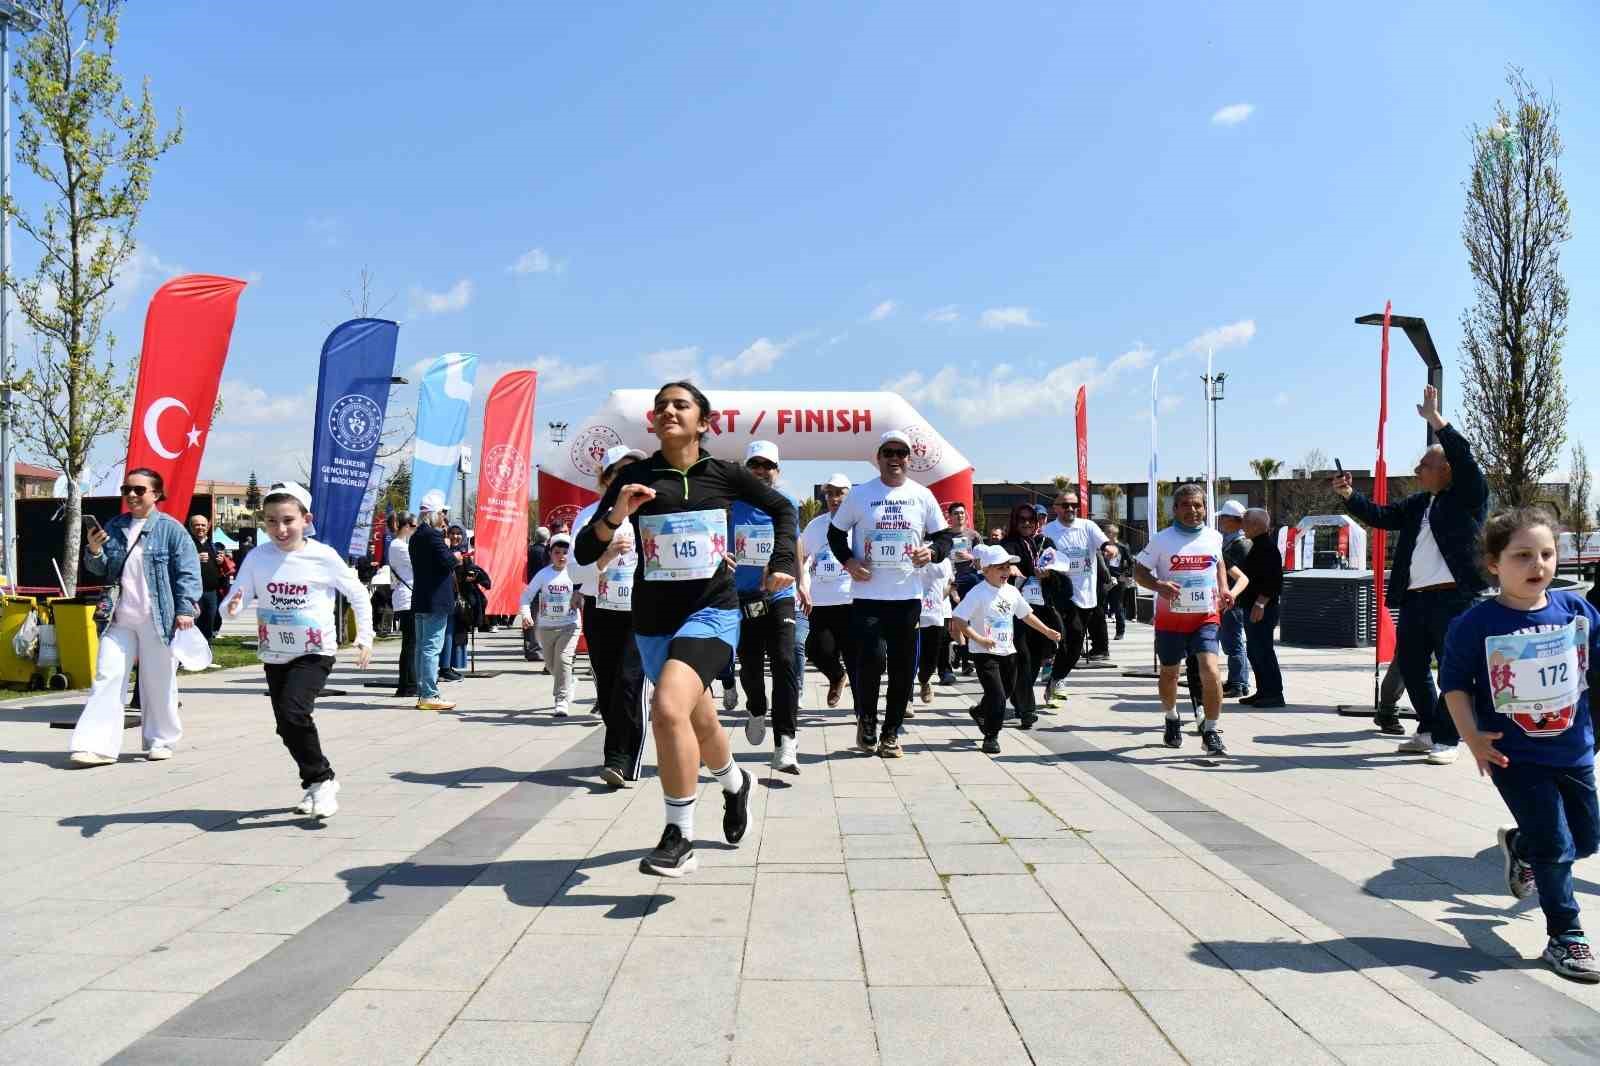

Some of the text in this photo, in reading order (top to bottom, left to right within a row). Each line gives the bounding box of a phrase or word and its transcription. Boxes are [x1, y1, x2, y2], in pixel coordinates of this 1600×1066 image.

[646, 409, 741, 435] SRT
[777, 409, 872, 434] FINISH
[672, 540, 697, 559] 145
[756, 542, 771, 553] 162
[880, 546, 895, 556] 170
[266, 582, 308, 596] OTİZM
[1191, 591, 1205, 601] 154
[1538, 662, 1568, 688] 172
